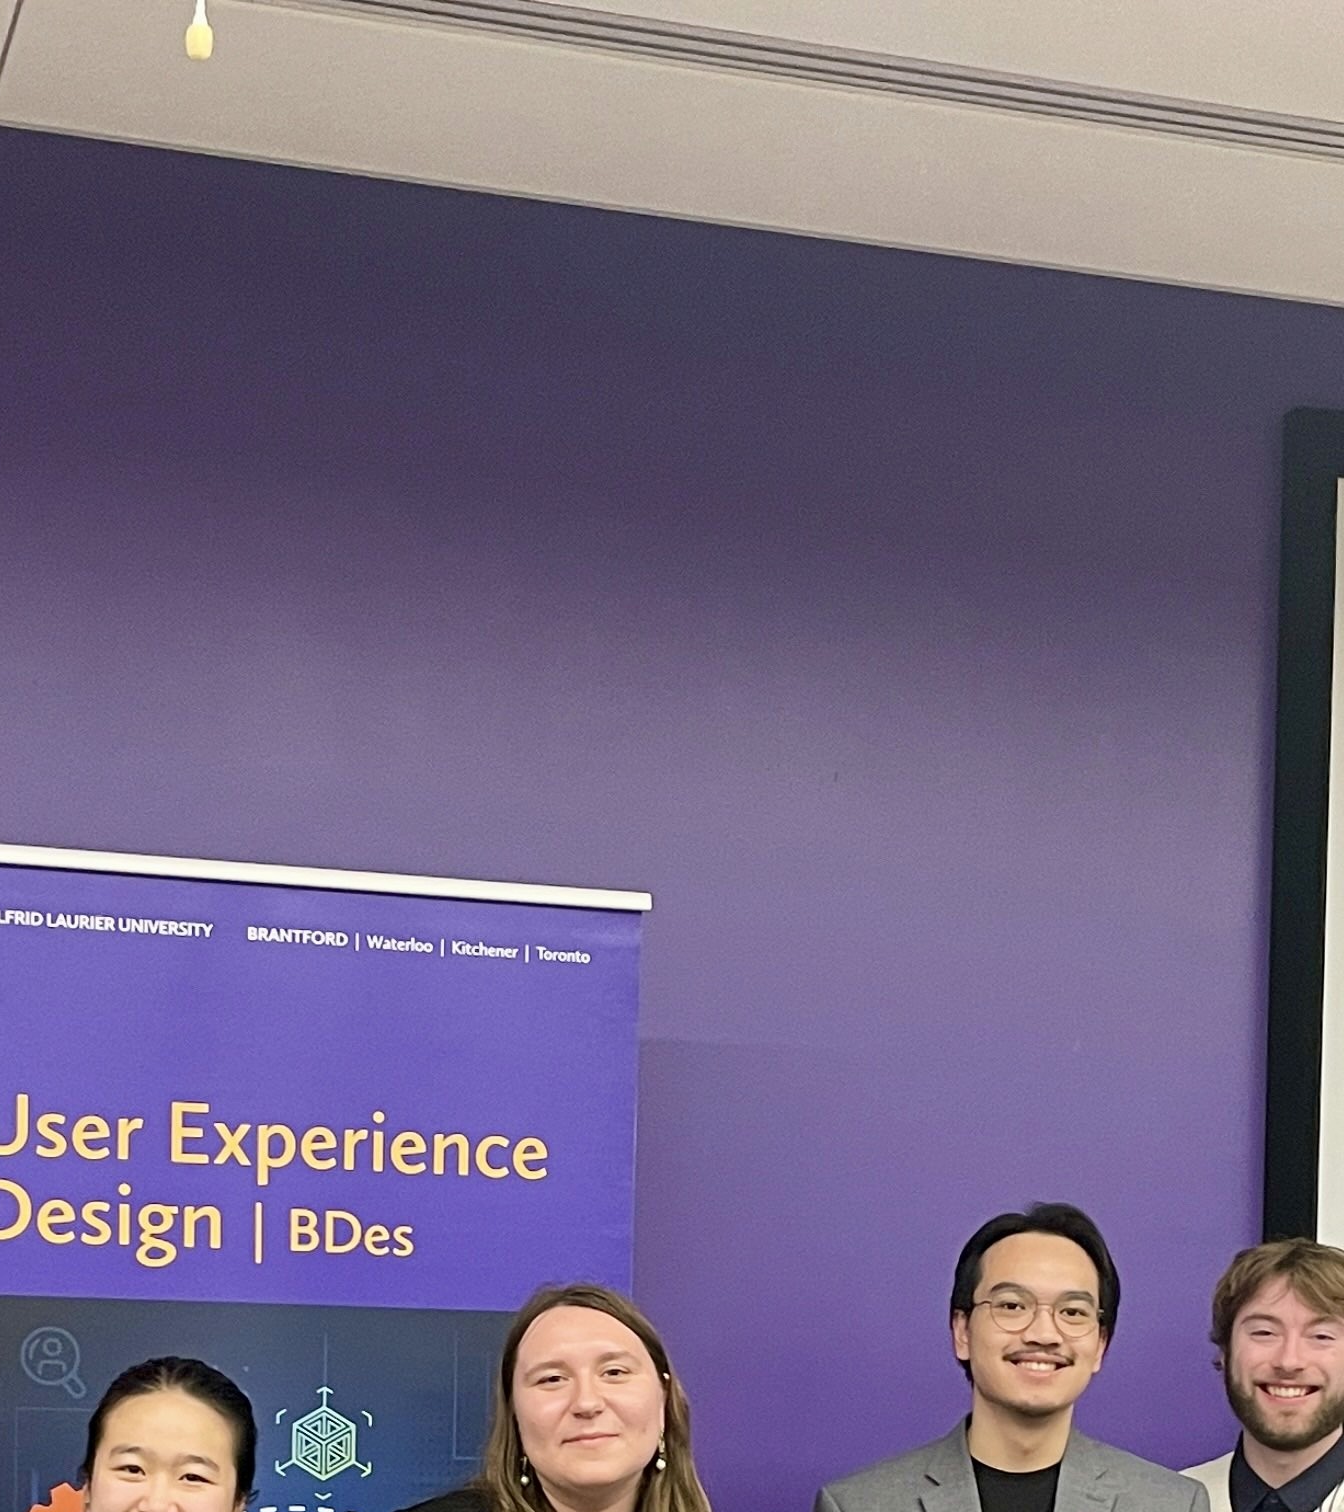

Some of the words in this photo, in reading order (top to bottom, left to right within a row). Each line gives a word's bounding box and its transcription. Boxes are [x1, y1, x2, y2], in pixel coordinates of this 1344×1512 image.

[46, 912, 116, 932] LAURIER
[118, 917, 214, 938] UNIVERSITY
[246, 926, 349, 947] BRANTFORD
[366, 934, 434, 954] Waterloo
[451, 940, 519, 960] Kitchener
[535, 946, 591, 965] Toronto
[169, 1100, 549, 1186] Experience
[288, 1207, 415, 1258] BDes
